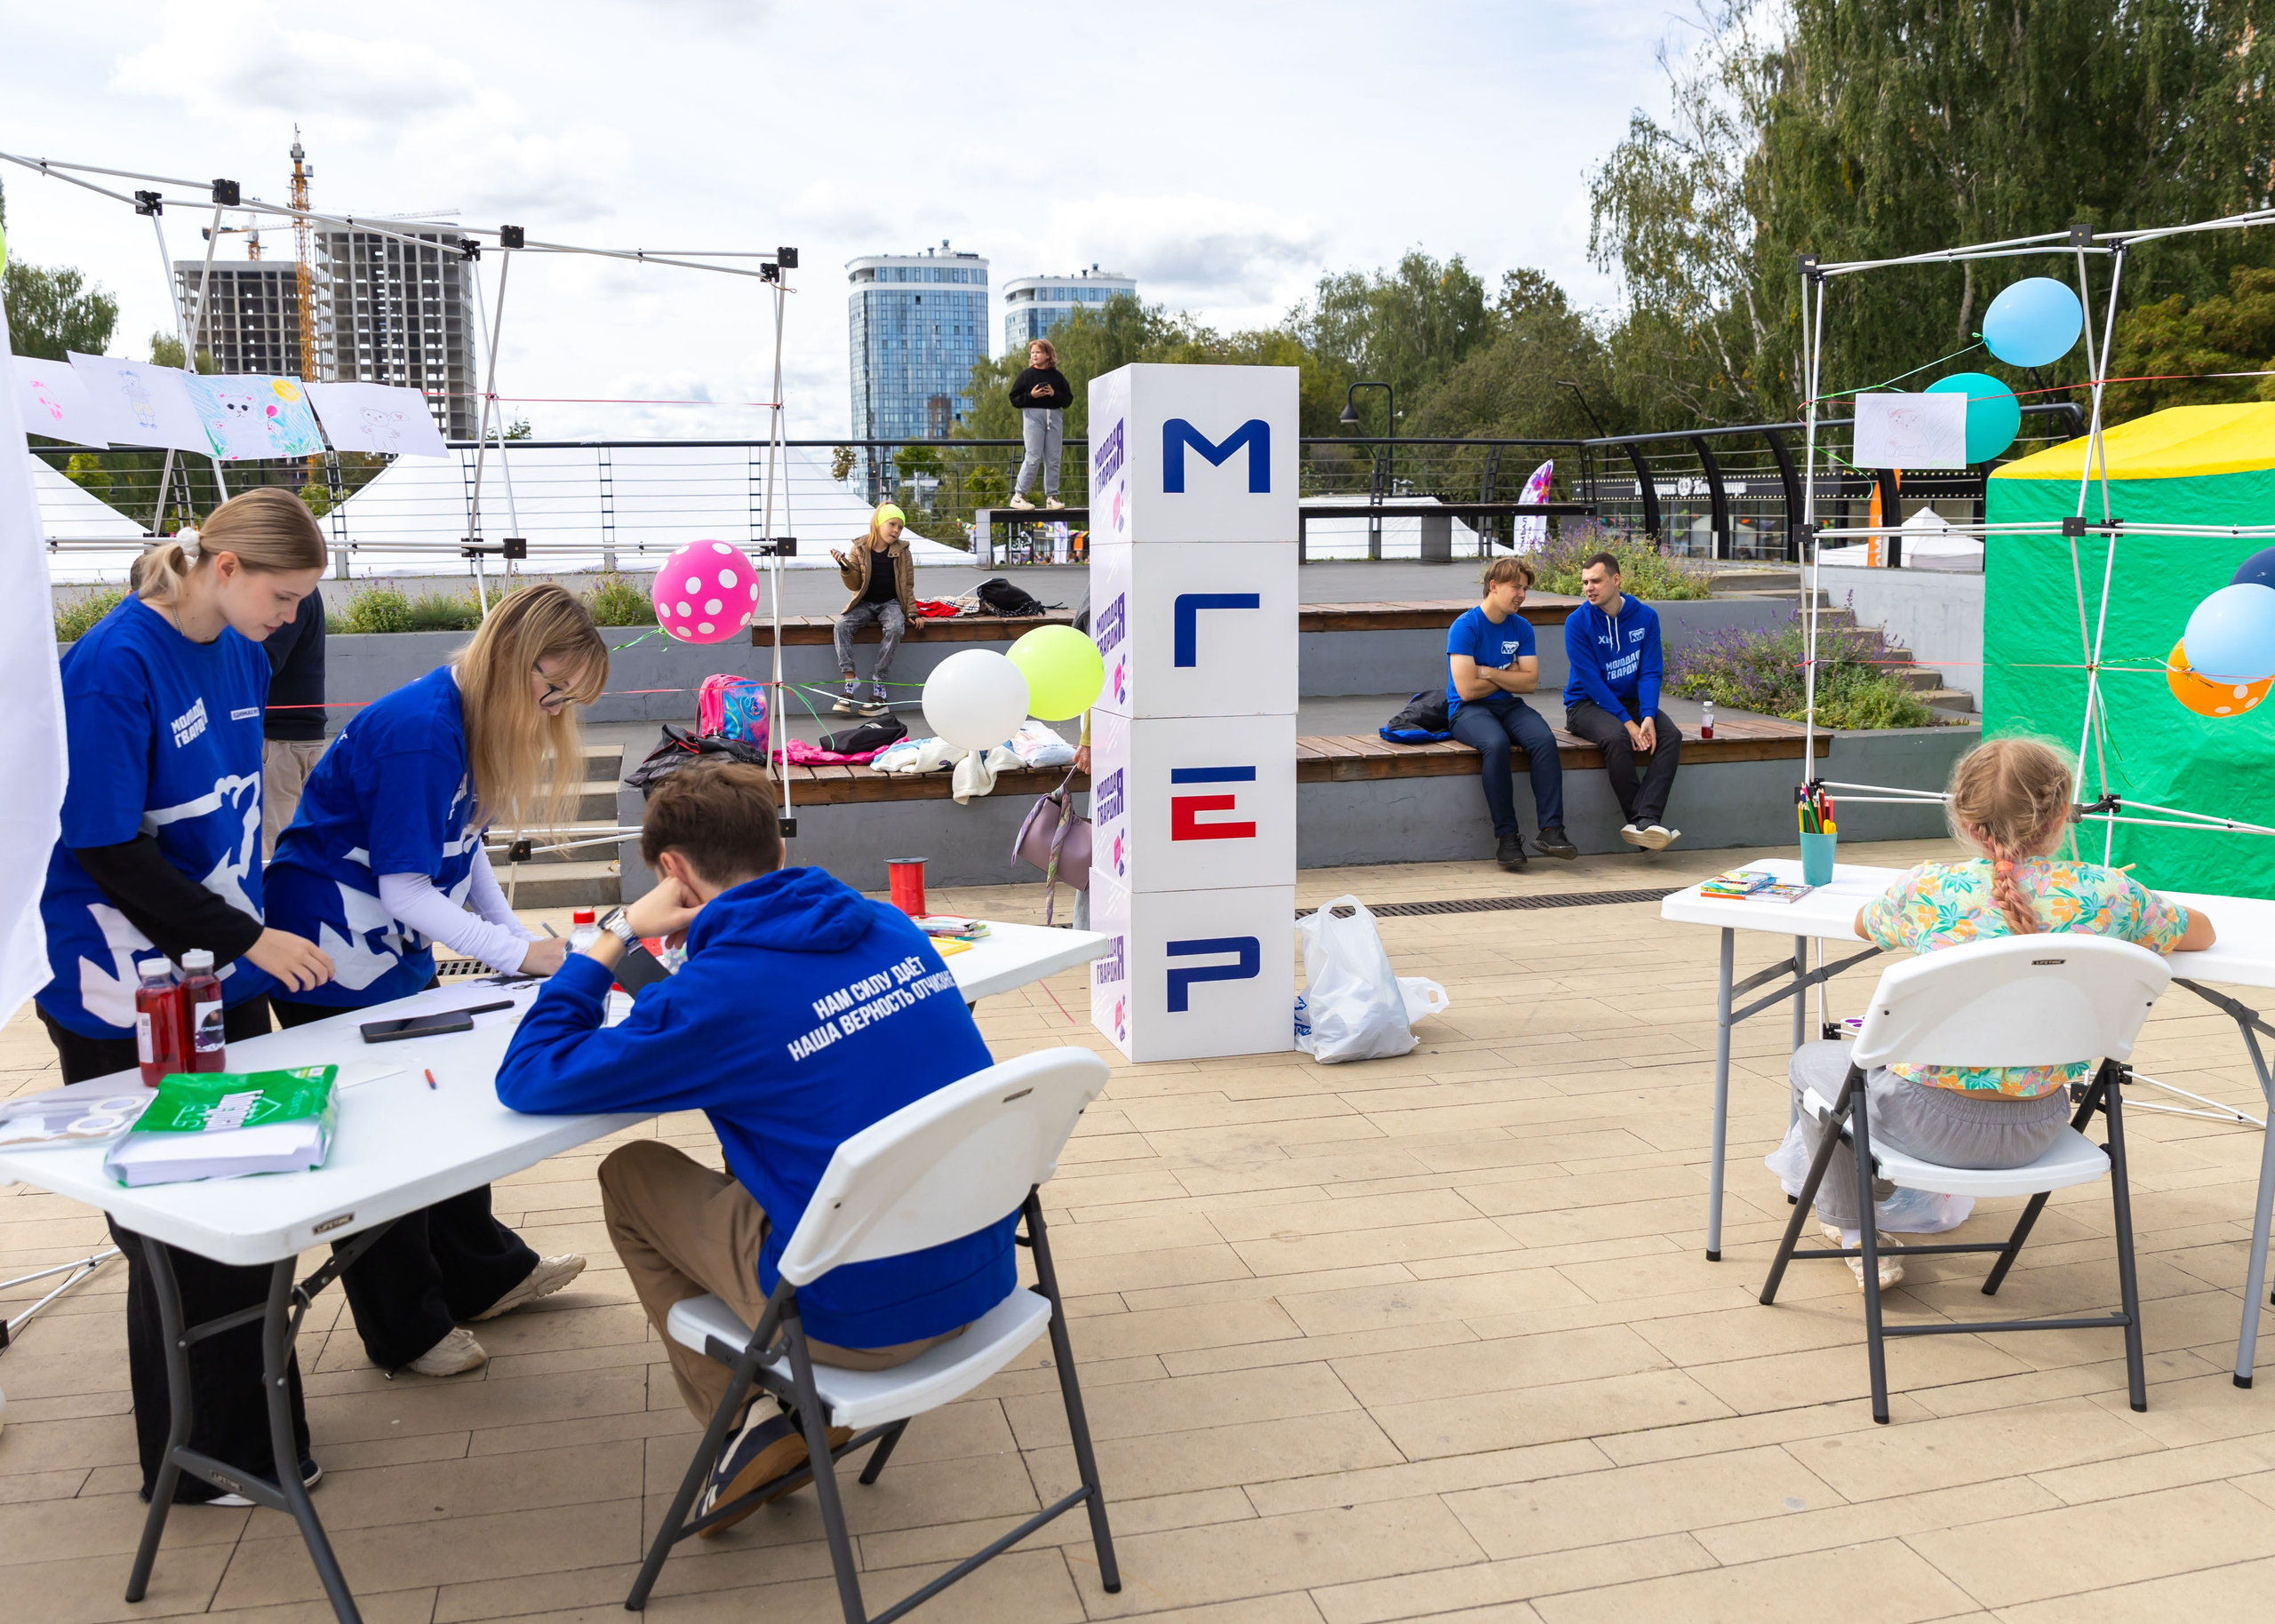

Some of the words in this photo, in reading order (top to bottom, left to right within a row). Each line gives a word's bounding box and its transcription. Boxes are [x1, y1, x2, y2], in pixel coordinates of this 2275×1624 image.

[1162, 418, 1271, 494] М
[1173, 593, 1260, 668] Г
[1170, 765, 1257, 842] Е
[811, 988, 855, 1021] НАМ
[850, 970, 893, 1002] СИЛУ
[890, 955, 927, 986] ДАЁТ
[1166, 935, 1260, 1013] Р
[786, 1021, 843, 1063] НАША
[838, 987, 915, 1037] ВЕРНОСТЬ
[912, 969, 956, 1000] ОТЧИЗНЕ
